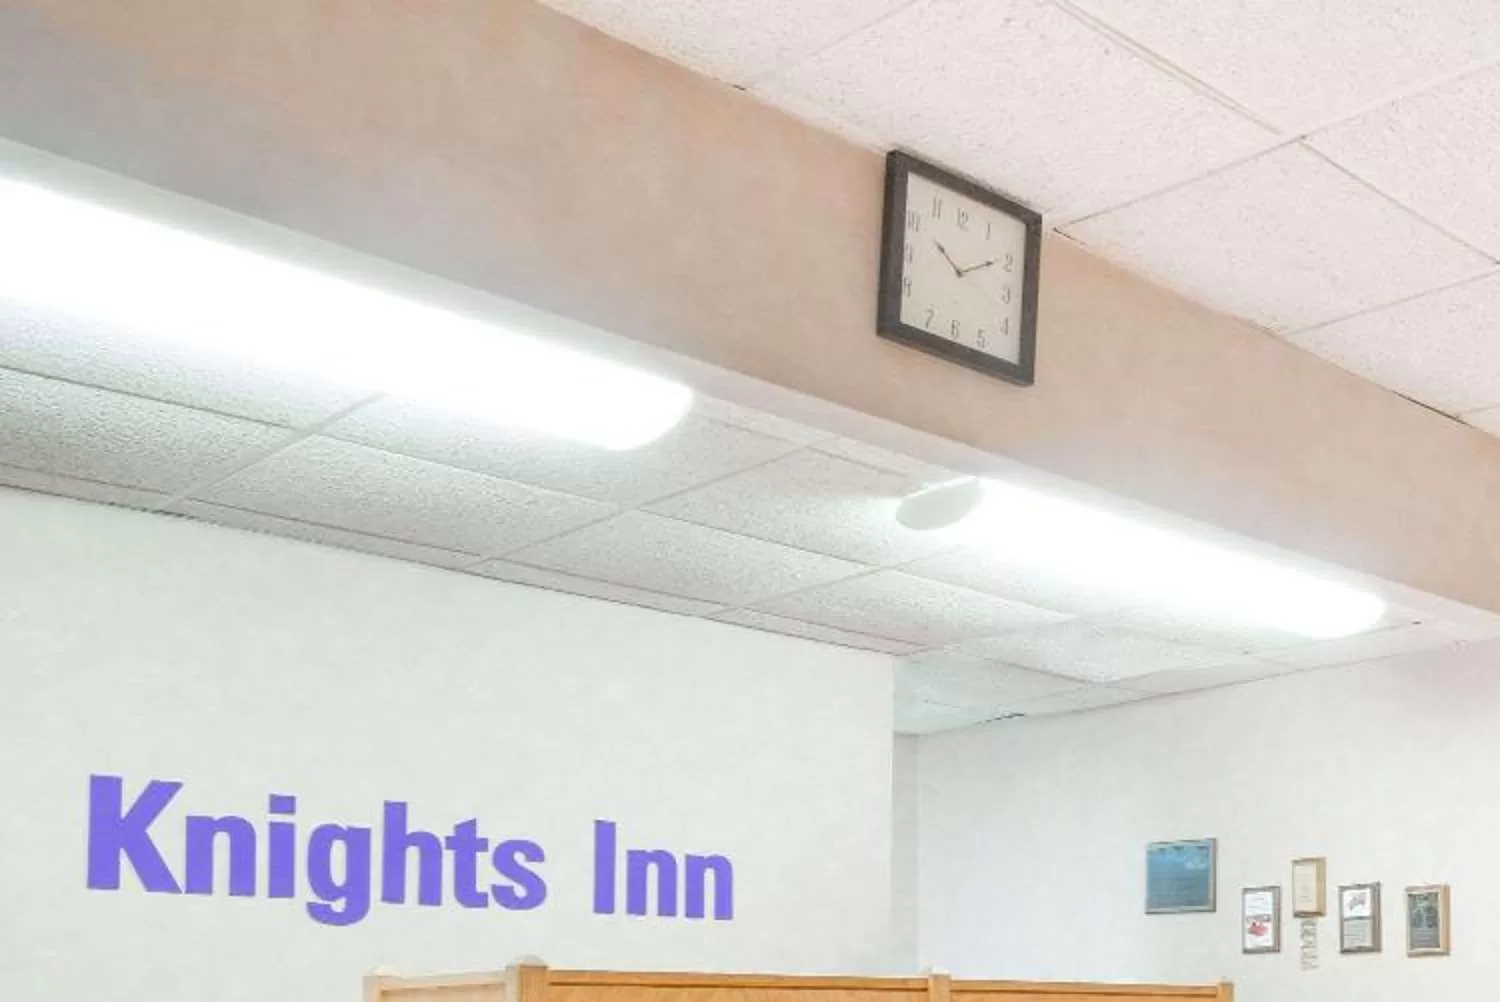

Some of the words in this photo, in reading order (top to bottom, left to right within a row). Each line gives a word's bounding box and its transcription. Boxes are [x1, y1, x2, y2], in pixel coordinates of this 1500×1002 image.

[931, 197, 942, 221] 11
[956, 207, 969, 231] 12
[984, 223, 991, 240] 1
[1002, 254, 1013, 273] 2
[924, 308, 935, 329] 7
[950, 319, 961, 341] 6
[976, 329, 986, 349] 5
[87, 774, 547, 926] Knights
[593, 819, 734, 920] Inn
